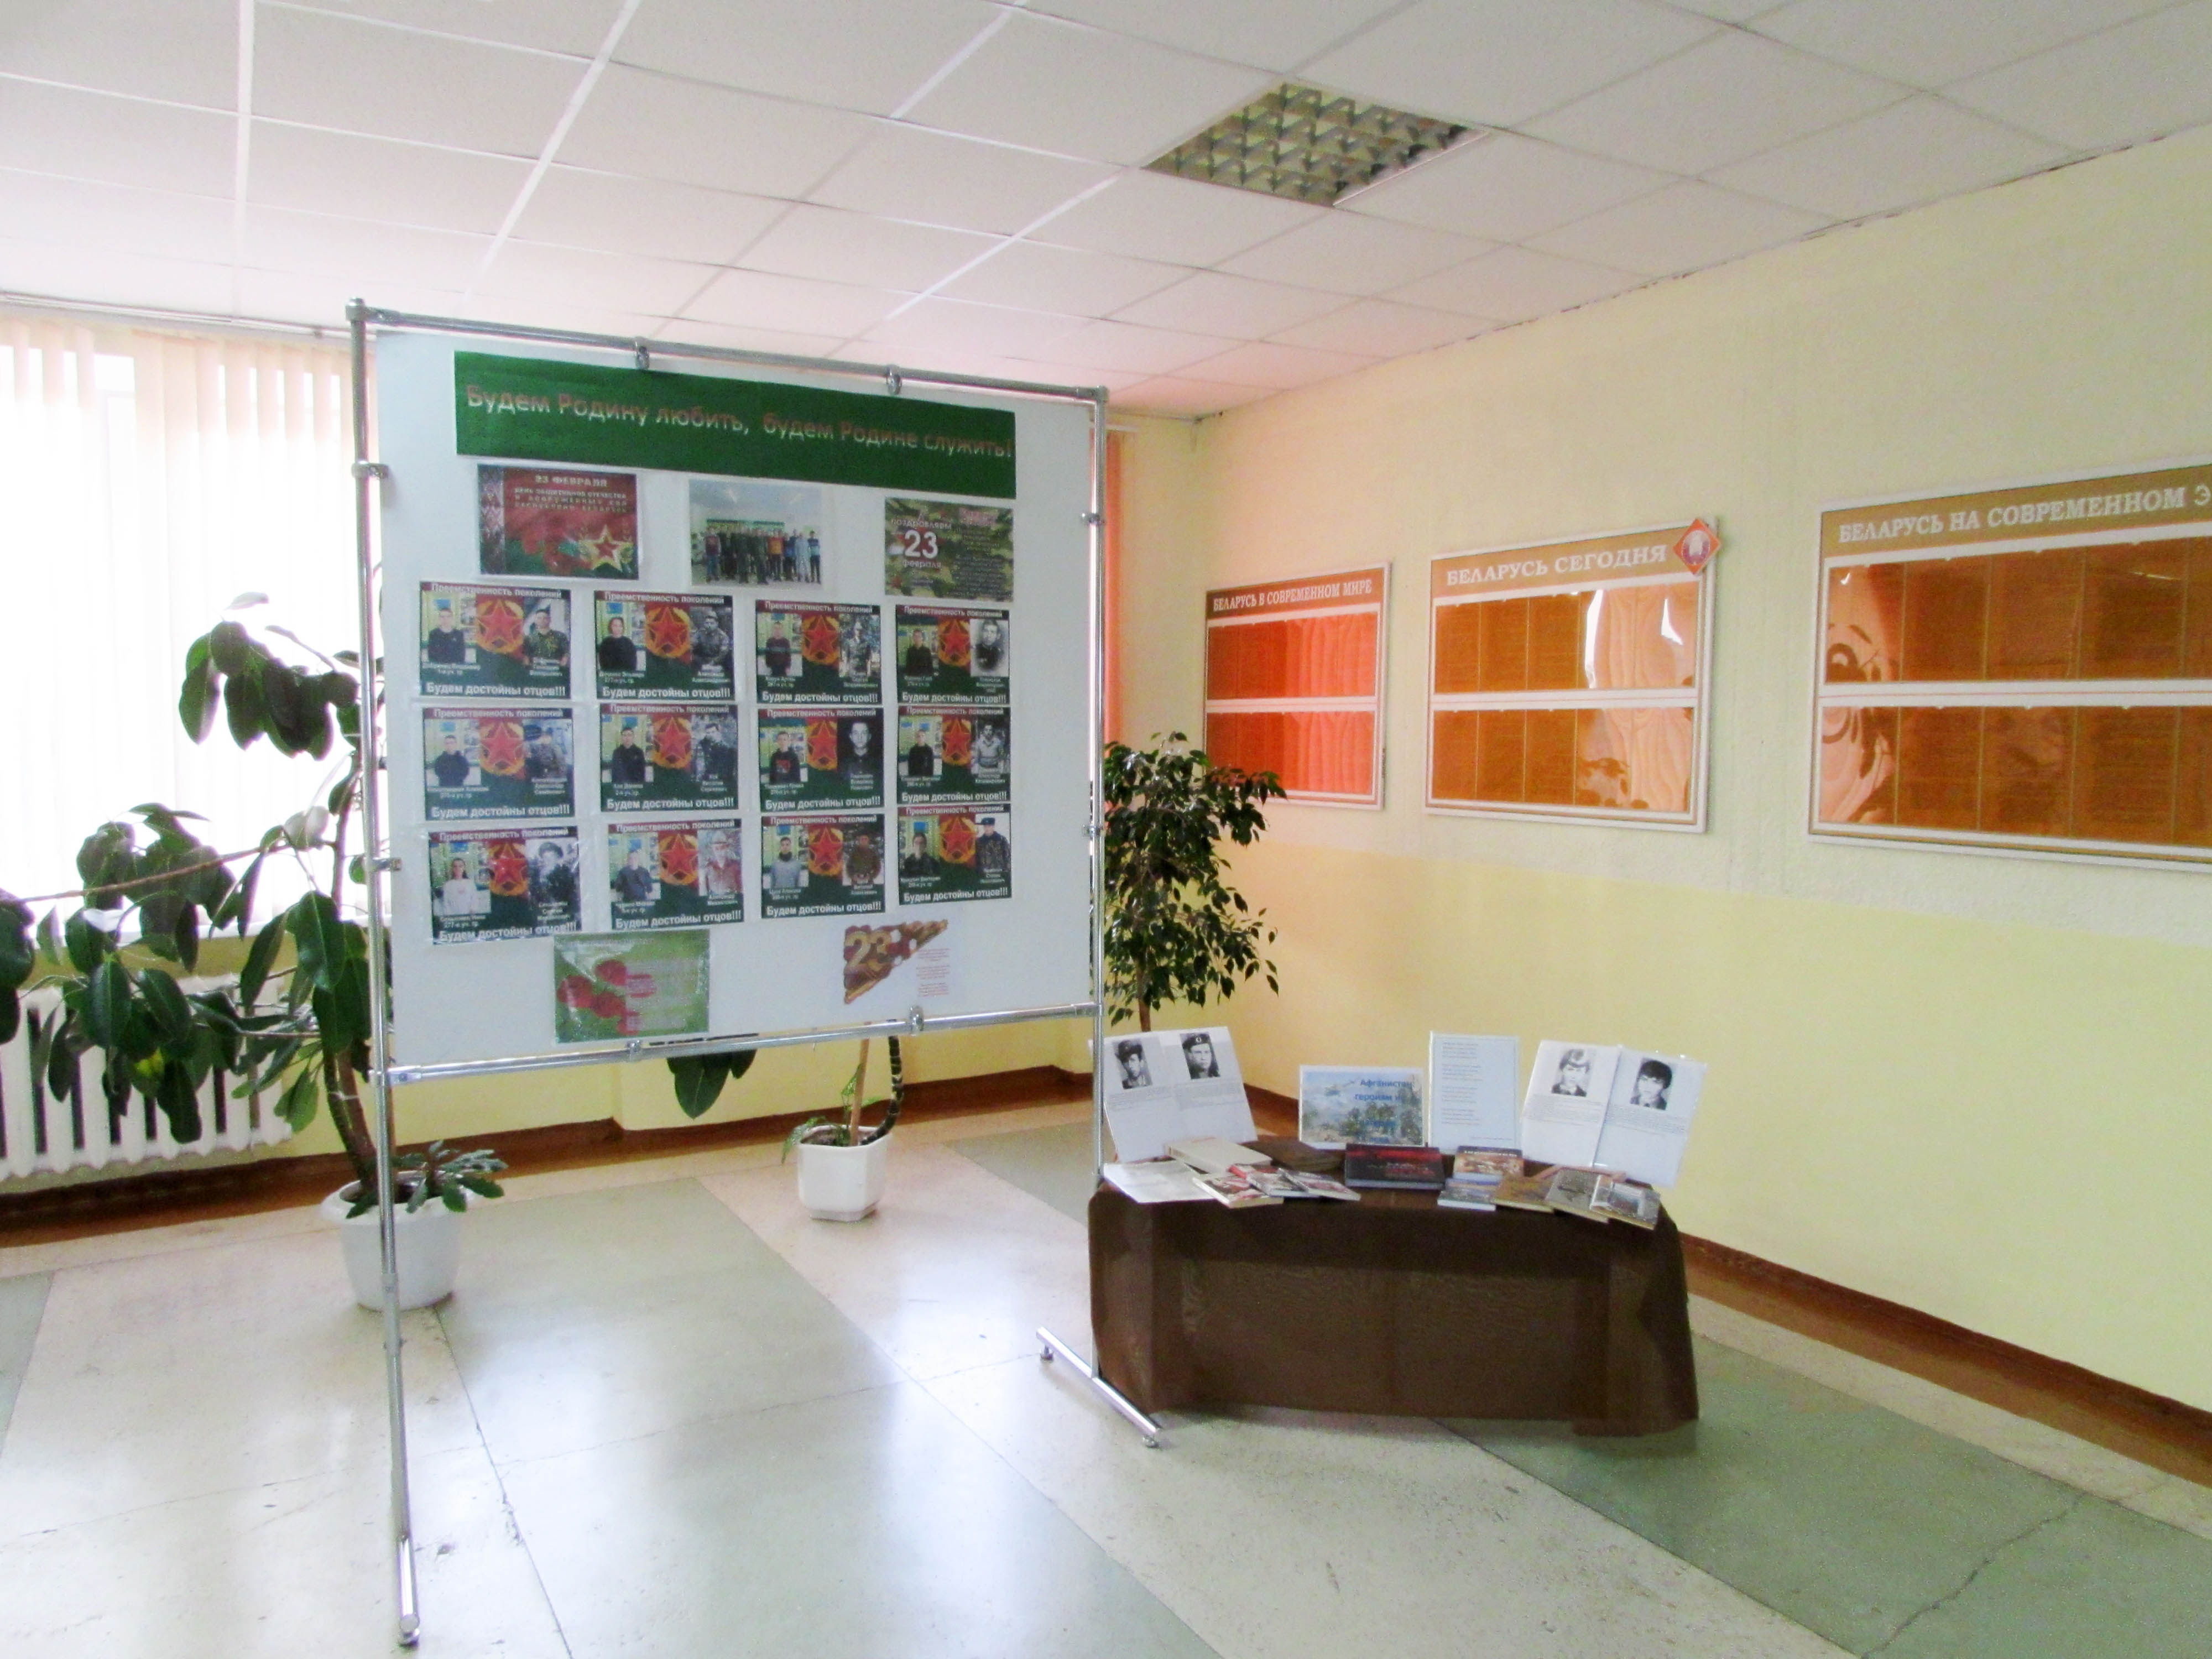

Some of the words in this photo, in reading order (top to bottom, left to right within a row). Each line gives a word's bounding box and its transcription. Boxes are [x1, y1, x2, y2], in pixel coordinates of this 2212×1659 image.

[466, 384, 550, 415] Будем
[558, 393, 650, 426] Родину
[655, 406, 749, 435] любить,
[763, 412, 833, 441] будем
[840, 420, 919, 449] Родине
[924, 432, 1012, 458] служить!
[552, 476, 608, 487] ФЕВРАЛЯ
[1838, 514, 1944, 544] БЕЛАРУСЬ
[1949, 510, 1981, 532] НА
[1987, 486, 2185, 528] СОВРЕМЕННОМ
[905, 529, 939, 559] 23
[1446, 557, 1548, 586] БЕЛАРУСЬ
[1554, 544, 1668, 574] СЕГОДНЯ
[1213, 592, 1256, 612] БЕЛАРУСЬ
[1258, 594, 1265, 606] В
[1267, 581, 1340, 606] СОВРЕМЕННОМ
[1342, 579, 1372, 596] МИРЕ
[426, 682, 463, 695] Будем
[465, 683, 521, 695] достойны
[524, 686, 565, 697] отцов!!!
[603, 687, 636, 699] Будем
[638, 687, 689, 697] достойны
[692, 688, 731, 698] отцов!!!
[763, 691, 792, 703] Будем
[795, 692, 841, 702] достойны
[843, 693, 878, 703] отцов!!!
[902, 692, 930, 703] Будем
[931, 693, 973, 703] достойны
[974, 695, 1006, 704] отцов!!!
[607, 799, 641, 811] Будем
[642, 798, 693, 809] достойны
[695, 797, 734, 808] отцов!!!
[765, 800, 795, 811] Будем
[797, 799, 843, 810] достойны
[846, 796, 881, 807] отцов!!!
[902, 792, 930, 804] Будем
[931, 792, 973, 802] достойны
[975, 791, 1007, 801] отцов!!!
[431, 806, 468, 820] Будем
[471, 806, 525, 818] достойны
[528, 804, 570, 815] отцов!!!
[904, 892, 931, 904] Будем
[933, 889, 974, 901] достойны
[976, 887, 1008, 897] отцов!!!
[767, 905, 797, 916] Будем
[799, 903, 844, 915] достойны
[846, 901, 881, 912] отцов!!!
[615, 918, 649, 930] Будем
[651, 914, 701, 927] достойны
[703, 910, 741, 922] отцов!!!
[478, 926, 533, 940] достойны
